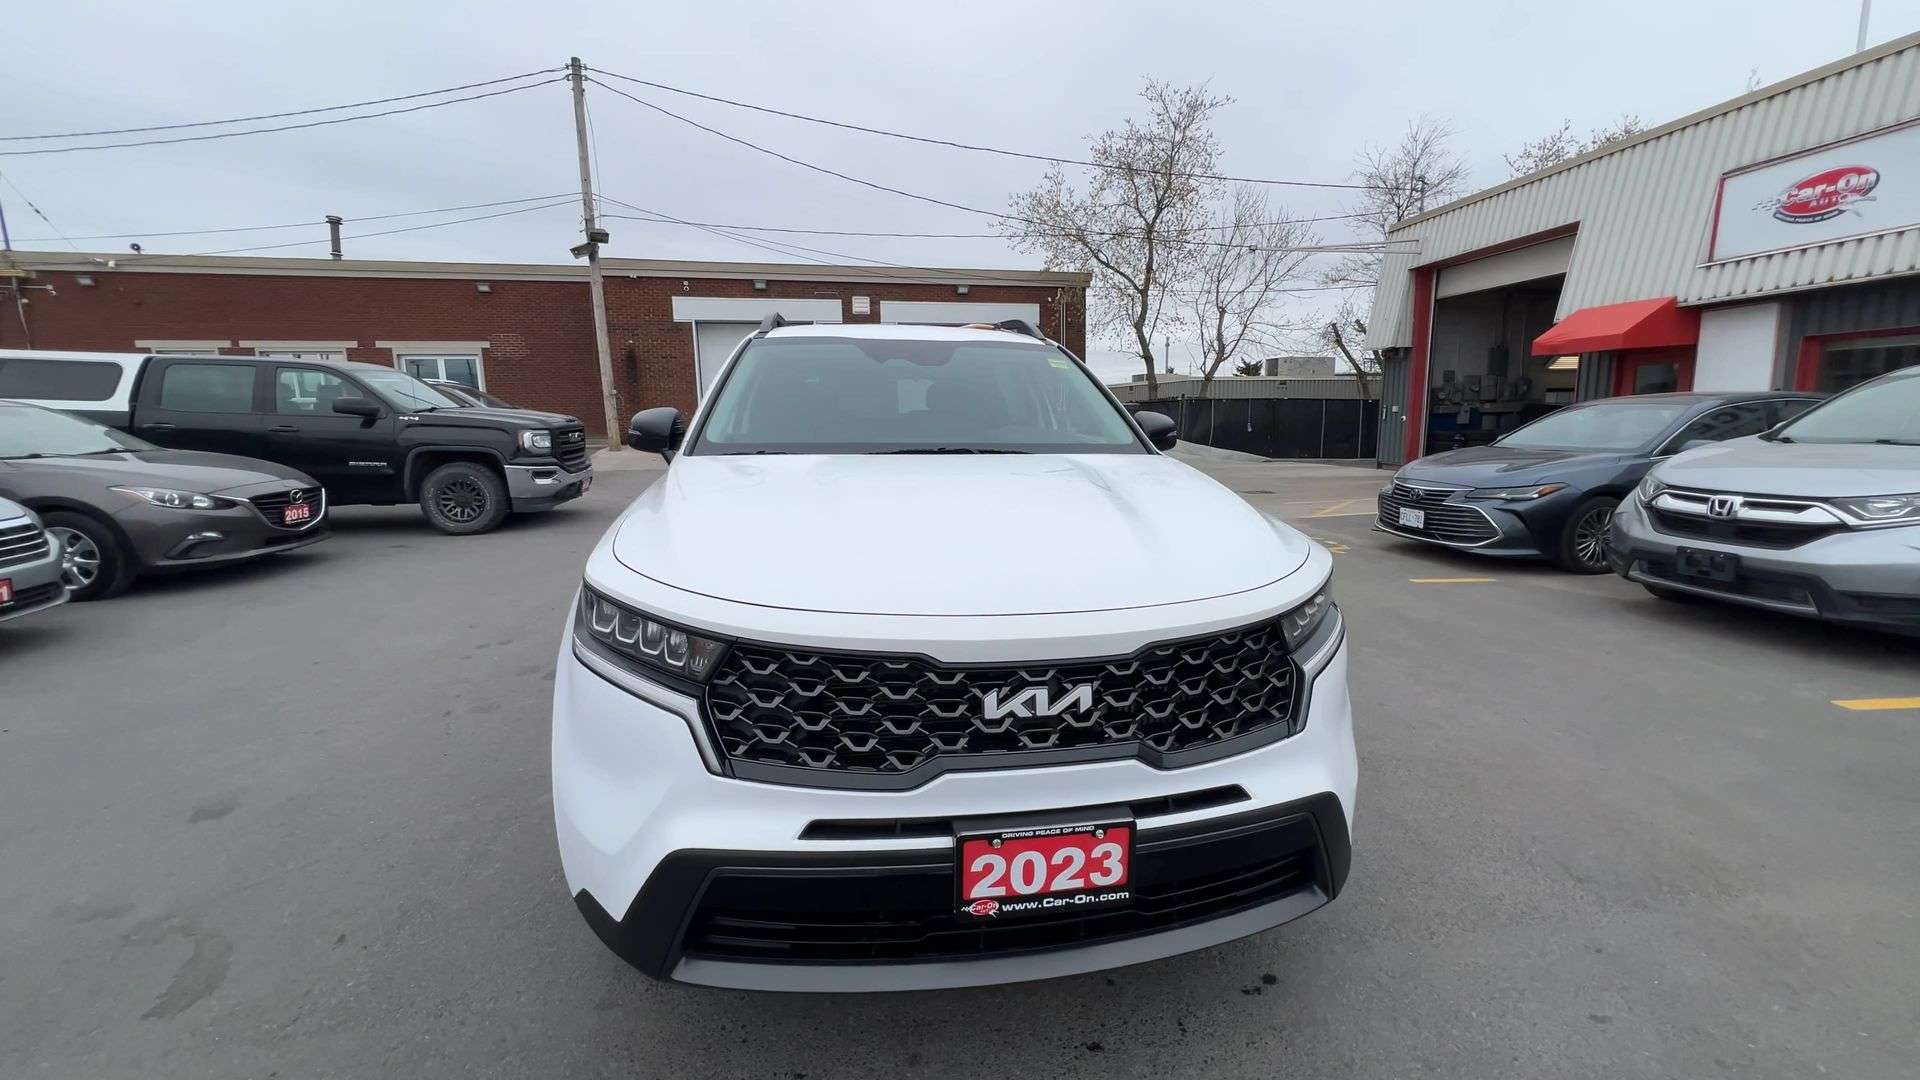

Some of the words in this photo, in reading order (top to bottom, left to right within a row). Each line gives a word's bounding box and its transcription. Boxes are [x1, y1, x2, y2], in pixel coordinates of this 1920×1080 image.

[1781, 172, 1878, 207] Car-On
[285, 507, 310, 521] 2015
[983, 683, 1093, 719] KIA
[1002, 831, 1034, 839] DRIVING
[1035, 828, 1061, 836] PEACE
[970, 842, 1124, 898] 2023
[1002, 891, 1130, 912] www.Car-On.com
